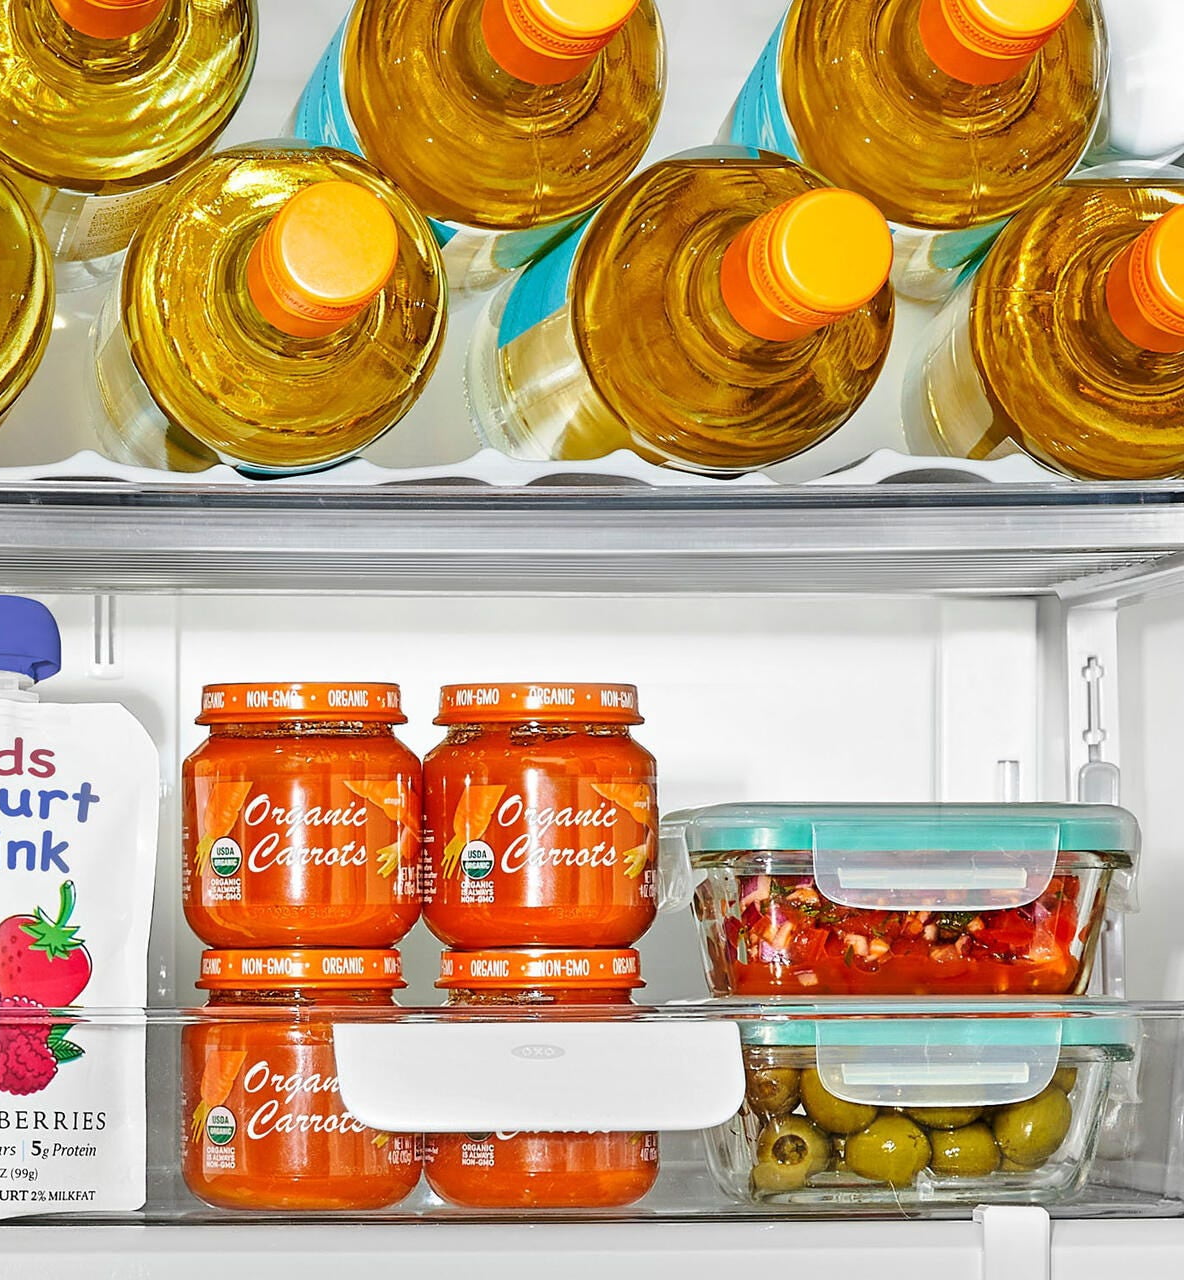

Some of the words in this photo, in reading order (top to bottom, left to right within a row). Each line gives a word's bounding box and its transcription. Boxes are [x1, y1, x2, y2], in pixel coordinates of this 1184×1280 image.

[246, 689, 300, 708] NON-GMO
[328, 689, 369, 707] ORGANIC
[456, 687, 500, 706] NON-GMO
[529, 688, 576, 706] ORGANIC
[600, 689, 634, 709] NON-GMO
[244, 793, 368, 838] Organic
[498, 794, 618, 838] Organic
[216, 847, 235, 856] USDA
[247, 832, 369, 874] Carrots
[467, 850, 487, 859] USDA
[500, 833, 618, 874] Carrots
[210, 878, 241, 886] ORGANIC
[460, 895, 495, 903] NON-GMO
[241, 957, 293, 975] NON-GMO
[322, 957, 364, 975] ORGANIC
[470, 959, 509, 977] ORGANIC
[538, 959, 590, 977] NON-GMO
[243, 1060, 341, 1104] Organ
[211, 1115, 229, 1124] USDA
[247, 1099, 367, 1140] Carrots
[31, 1140, 49, 1160] 5g
[52, 1143, 97, 1157] Protein
[462, 1144, 494, 1152] ORGANIC
[206, 1161, 235, 1169] NON-GMO
[462, 1158, 494, 1166] NON-GMO
[10, 1168, 38, 1182] (99g)
[31, 1190, 47, 1202] 2%
[47, 1190, 96, 1201] MILKFAT
